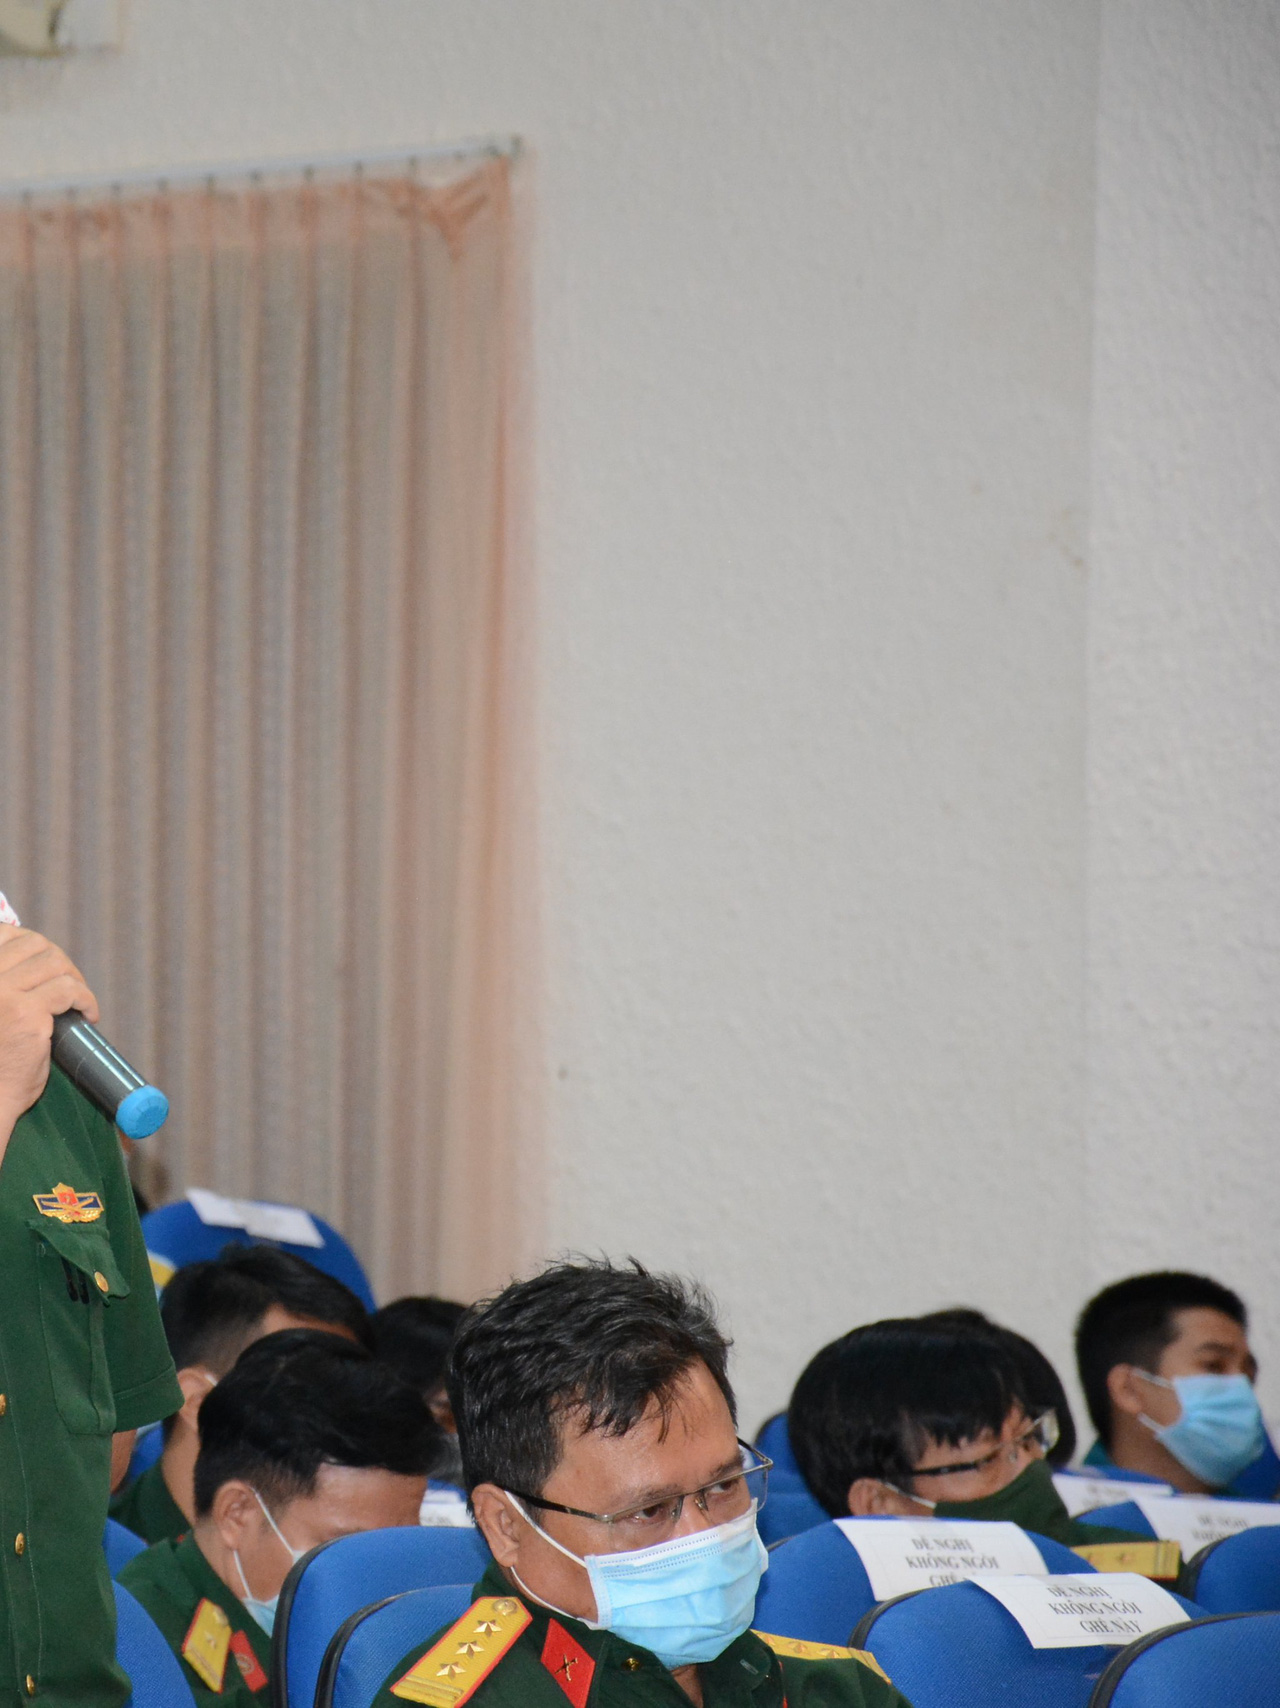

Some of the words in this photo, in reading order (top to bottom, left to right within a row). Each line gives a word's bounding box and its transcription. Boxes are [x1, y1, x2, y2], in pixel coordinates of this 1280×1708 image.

[911, 1535, 934, 1550] ĐỀ
[932, 1538, 975, 1553] NGHỊ
[905, 1552, 960, 1569] KHÔNG
[960, 1552, 1000, 1569] NGỒI
[1047, 1584, 1073, 1598] ĐỀ
[1068, 1586, 1113, 1600] NGHỊ
[1048, 1599, 1105, 1615] KHÔNG
[1101, 1599, 1142, 1614] NGỒI
[1080, 1616, 1114, 1633] GHẾ
[1110, 1616, 1142, 1633] NÀY
